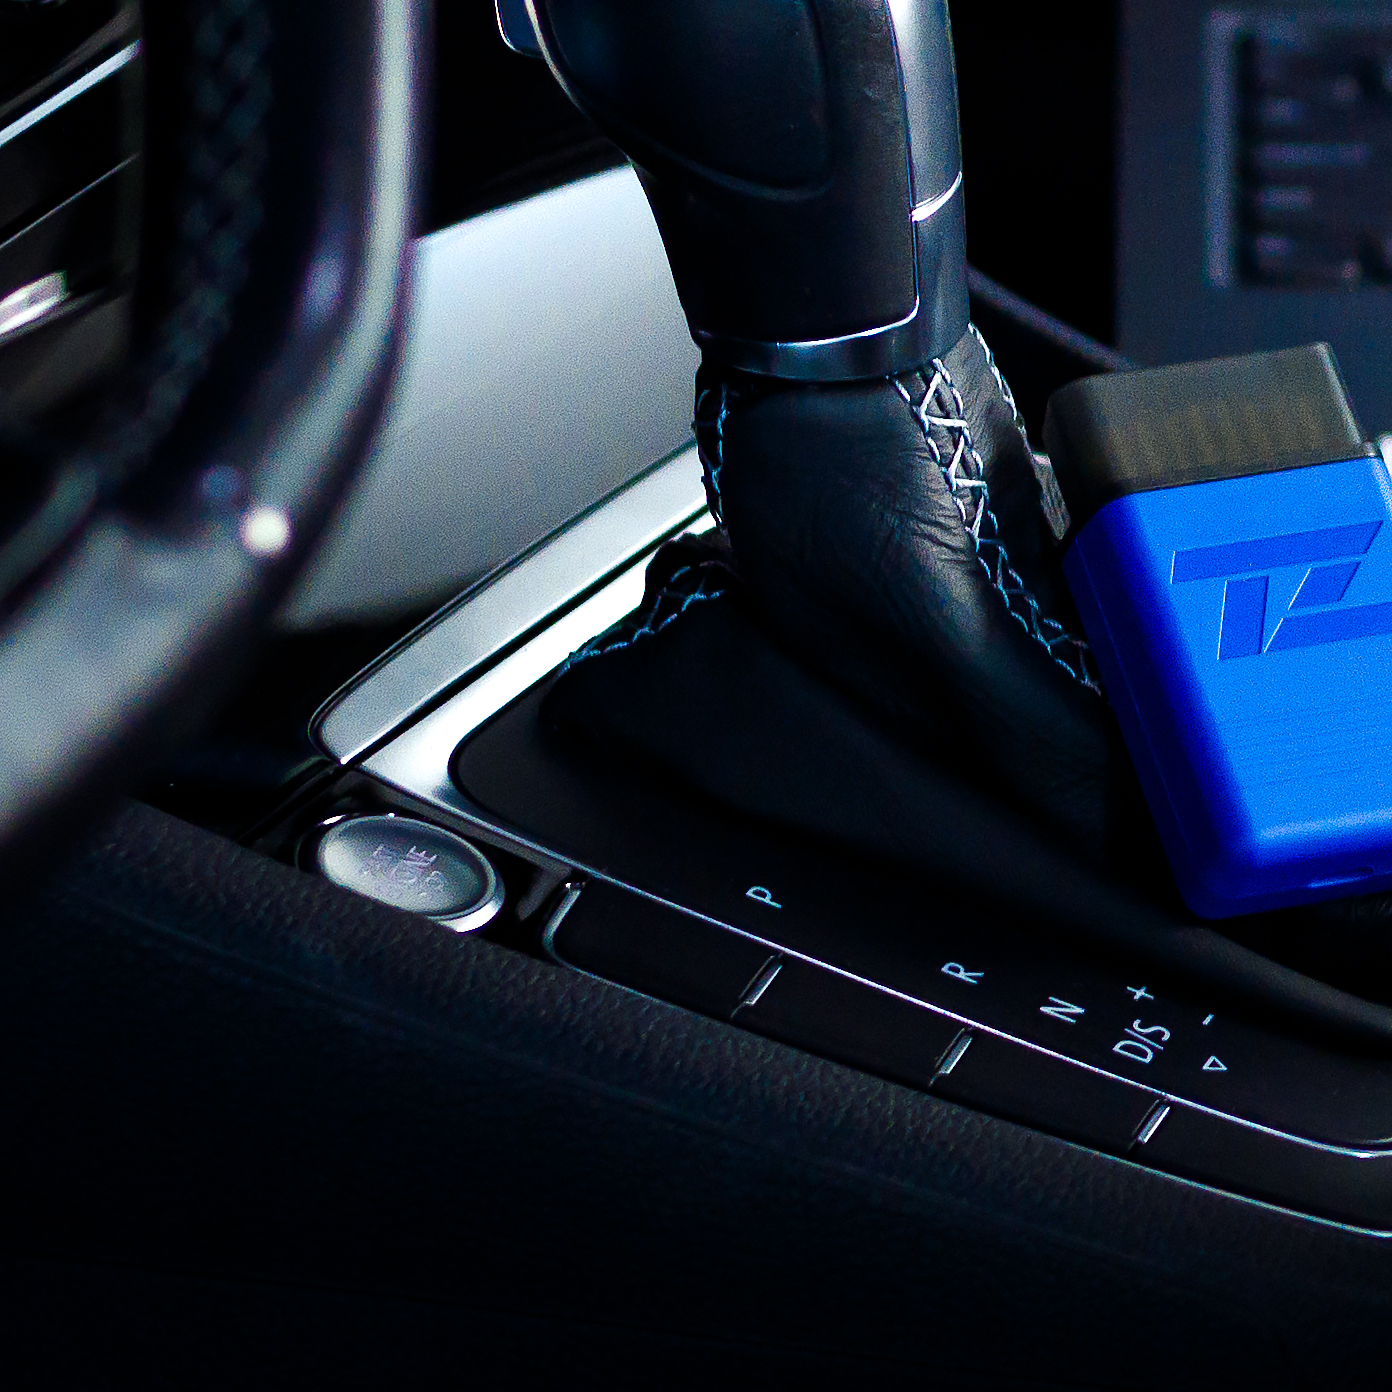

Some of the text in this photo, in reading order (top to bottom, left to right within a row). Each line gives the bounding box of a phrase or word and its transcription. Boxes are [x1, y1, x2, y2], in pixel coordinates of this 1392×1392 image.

[745, 885, 783, 909] P
[940, 961, 985, 985] R
[1039, 996, 1086, 1024] N
[1111, 1018, 1172, 1065] D/S
